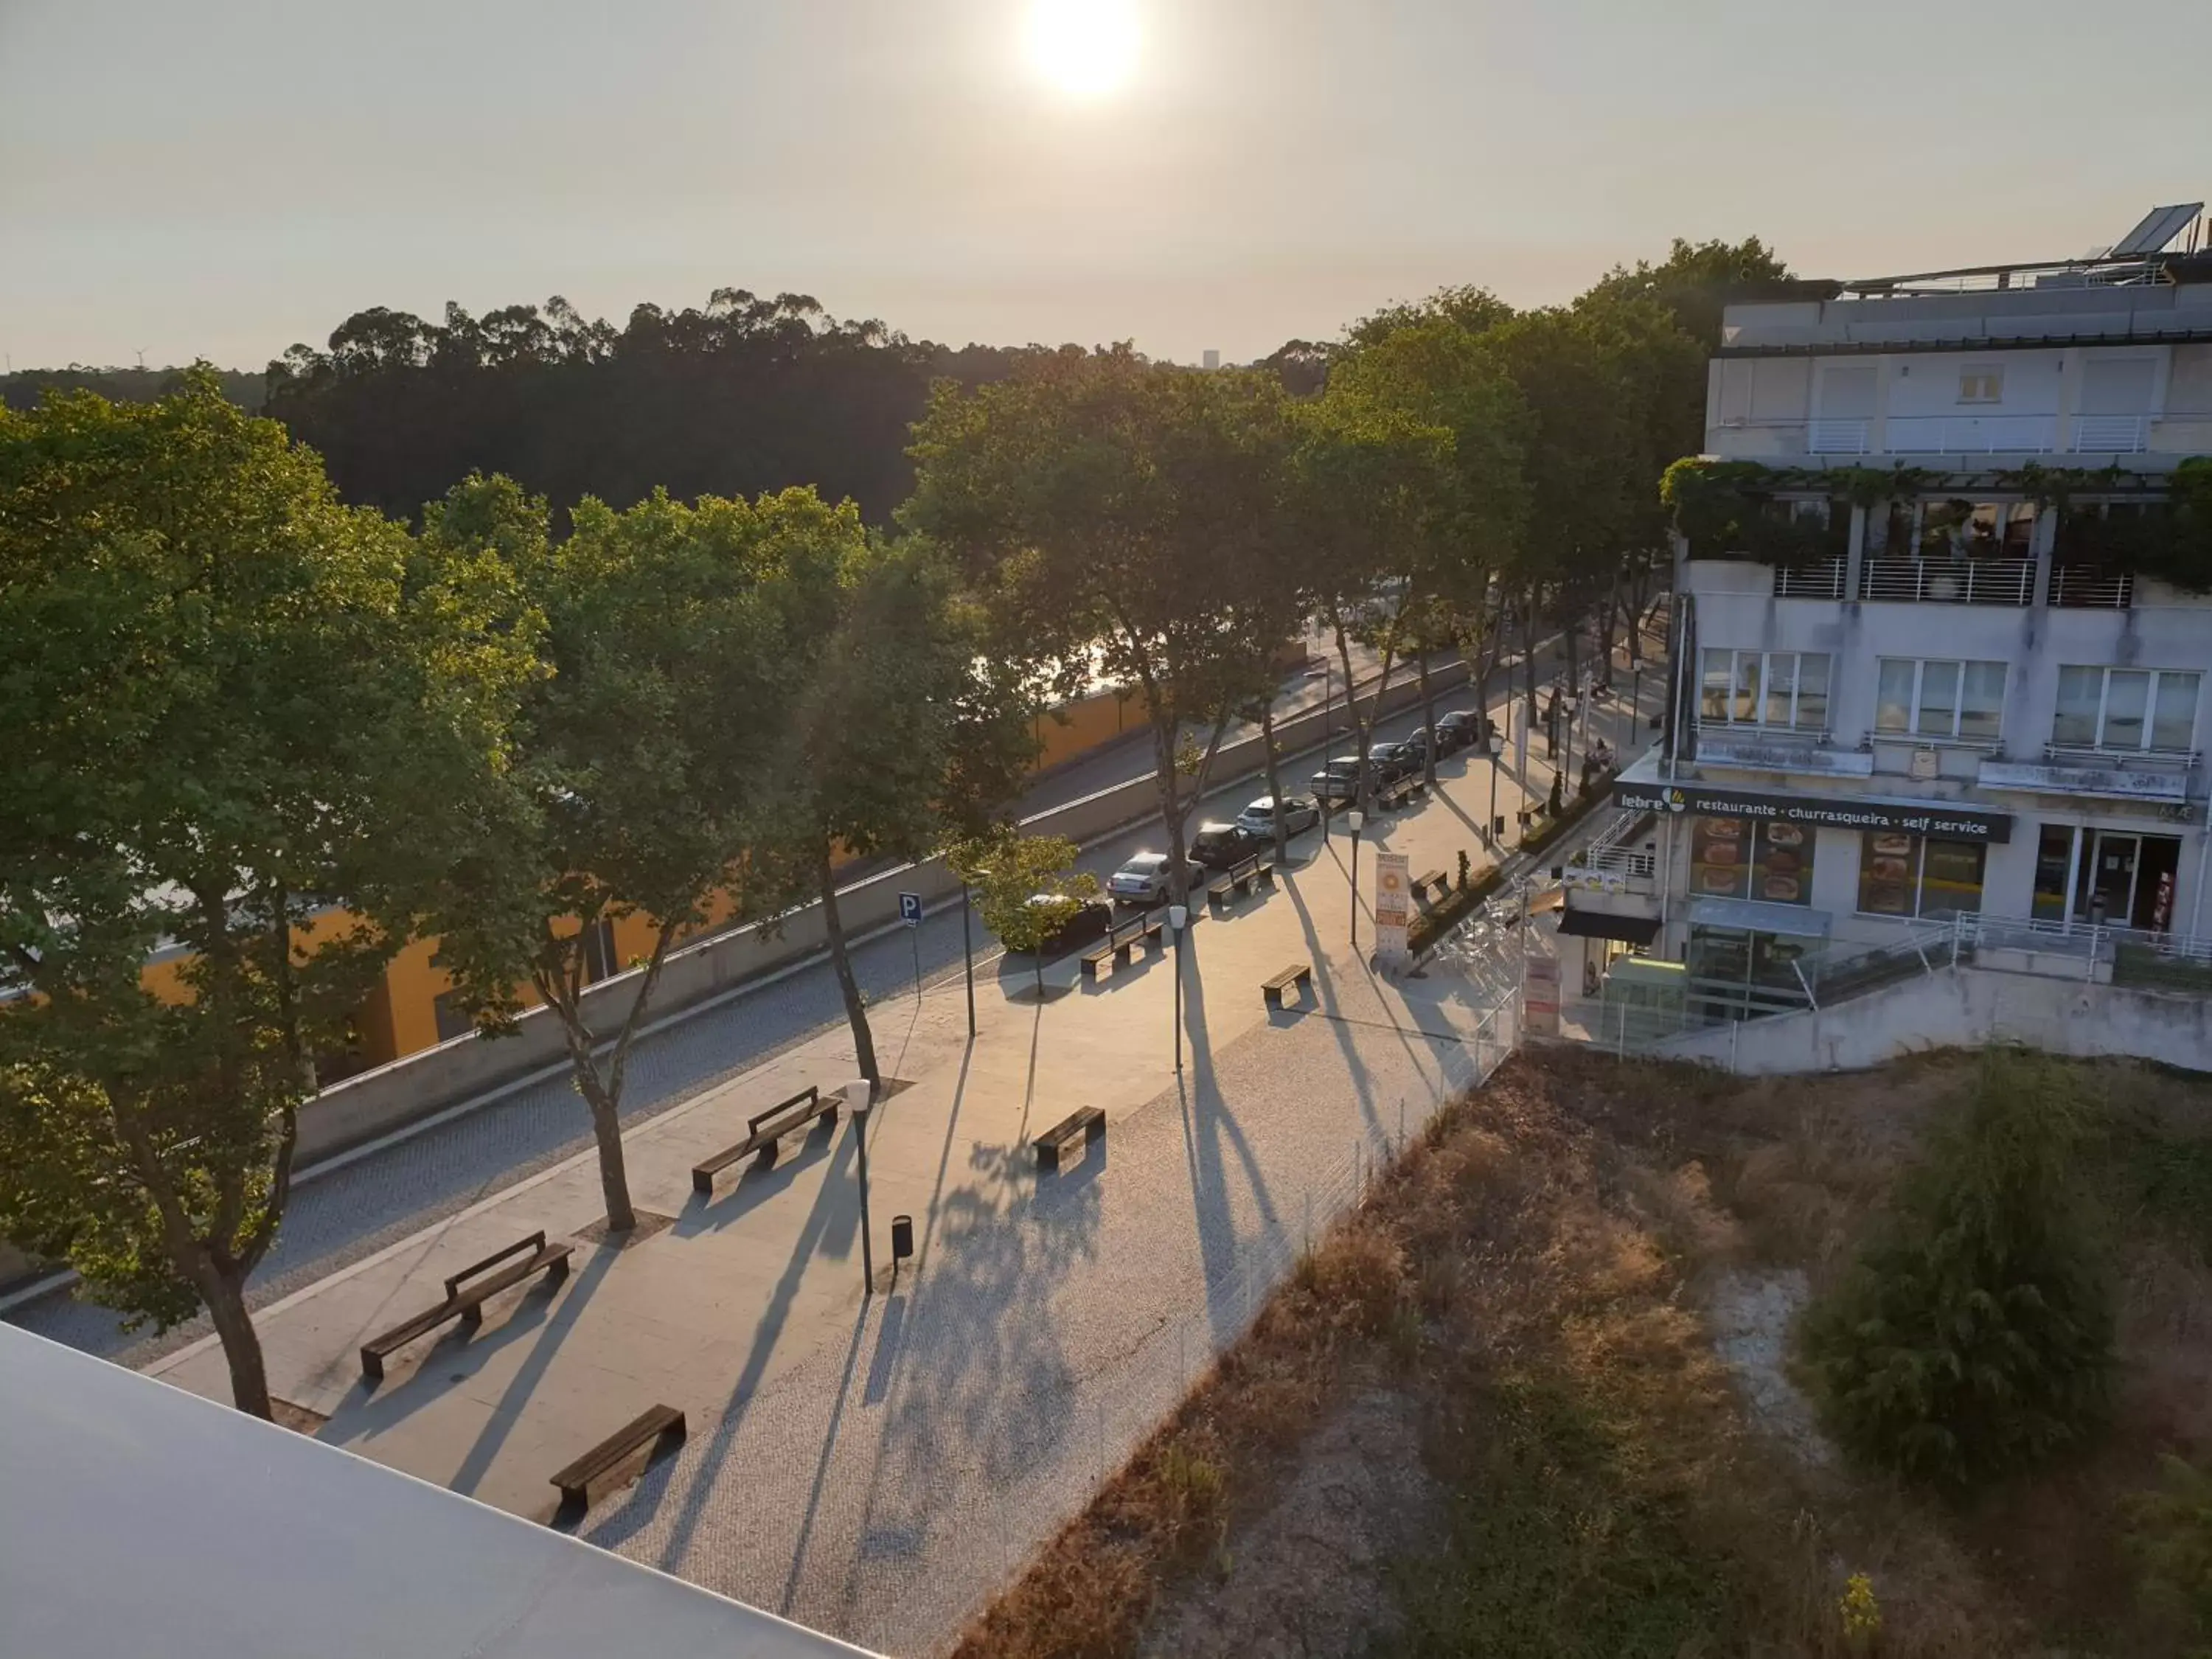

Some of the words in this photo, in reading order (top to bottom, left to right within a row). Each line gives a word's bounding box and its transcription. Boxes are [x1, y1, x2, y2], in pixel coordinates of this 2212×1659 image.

[1621, 793, 1663, 810] lebre
[1696, 799, 1776, 816] restaurante
[1788, 807, 1890, 826] churrasqueira
[1902, 816, 1930, 831] self
[1935, 820, 1988, 834] service
[902, 896, 917, 917] P
